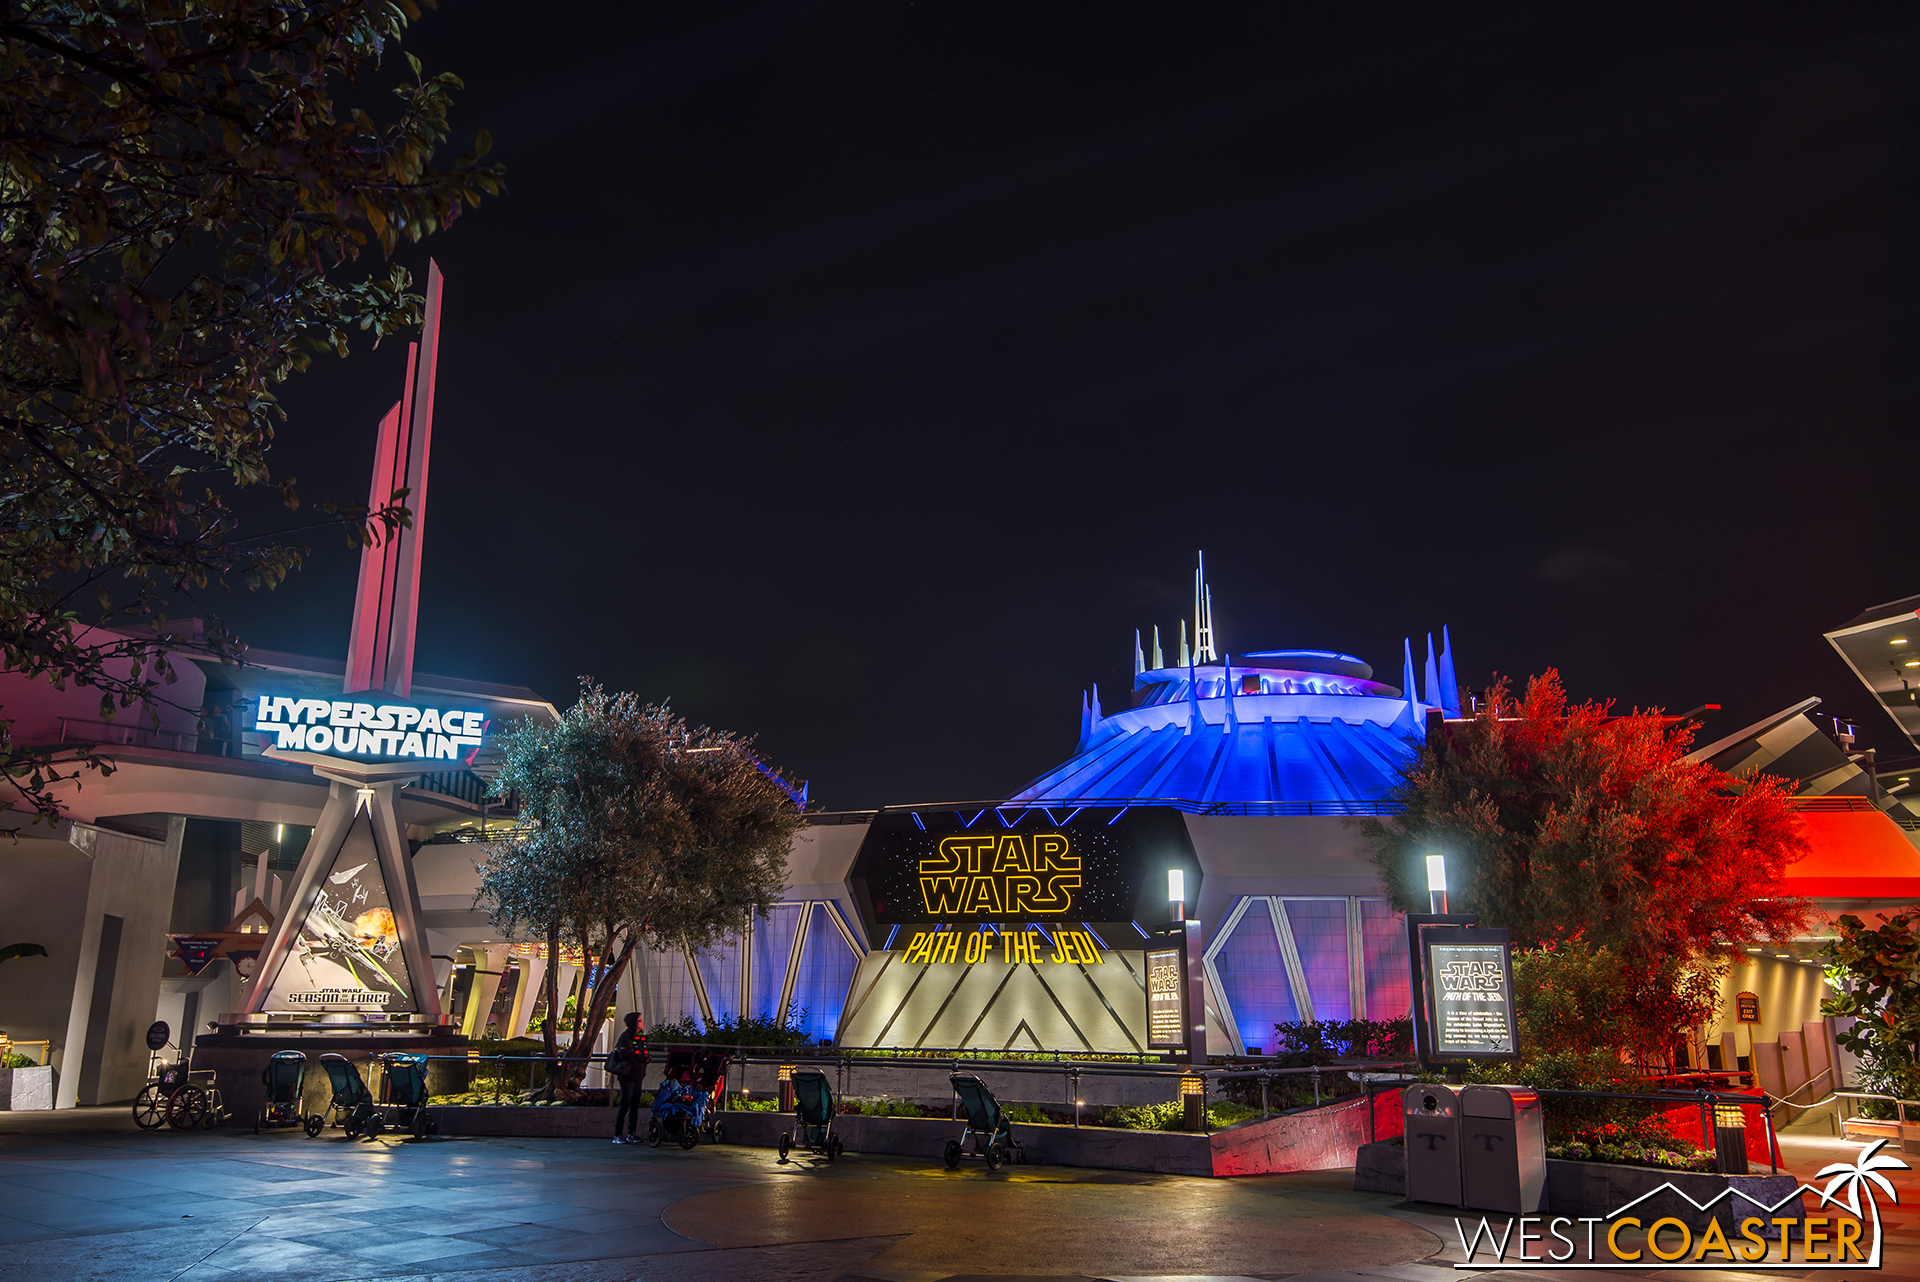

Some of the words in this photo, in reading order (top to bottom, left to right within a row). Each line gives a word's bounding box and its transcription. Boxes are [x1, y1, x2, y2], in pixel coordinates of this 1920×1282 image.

[257, 695, 484, 737] HYPERSPACE
[255, 722, 482, 760] MOUNTAIN
[919, 834, 1082, 874] STAR
[919, 874, 1082, 914] WARS
[900, 931, 963, 964] PATH
[964, 931, 994, 964] OF
[1000, 931, 1045, 964] THE
[1050, 931, 1105, 964] JEDI
[1149, 964, 1178, 979] STAR
[1440, 961, 1502, 976] STAR
[1150, 978, 1178, 992] WARS
[1440, 975, 1504, 990] WARS
[288, 993, 339, 1003] SEASON
[350, 993, 390, 1003] FORCE
[1442, 992, 1462, 1002] PATH
[1462, 992, 1471, 1002] OF
[1472, 992, 1486, 1002] THE
[1486, 992, 1504, 1002] JEDI
